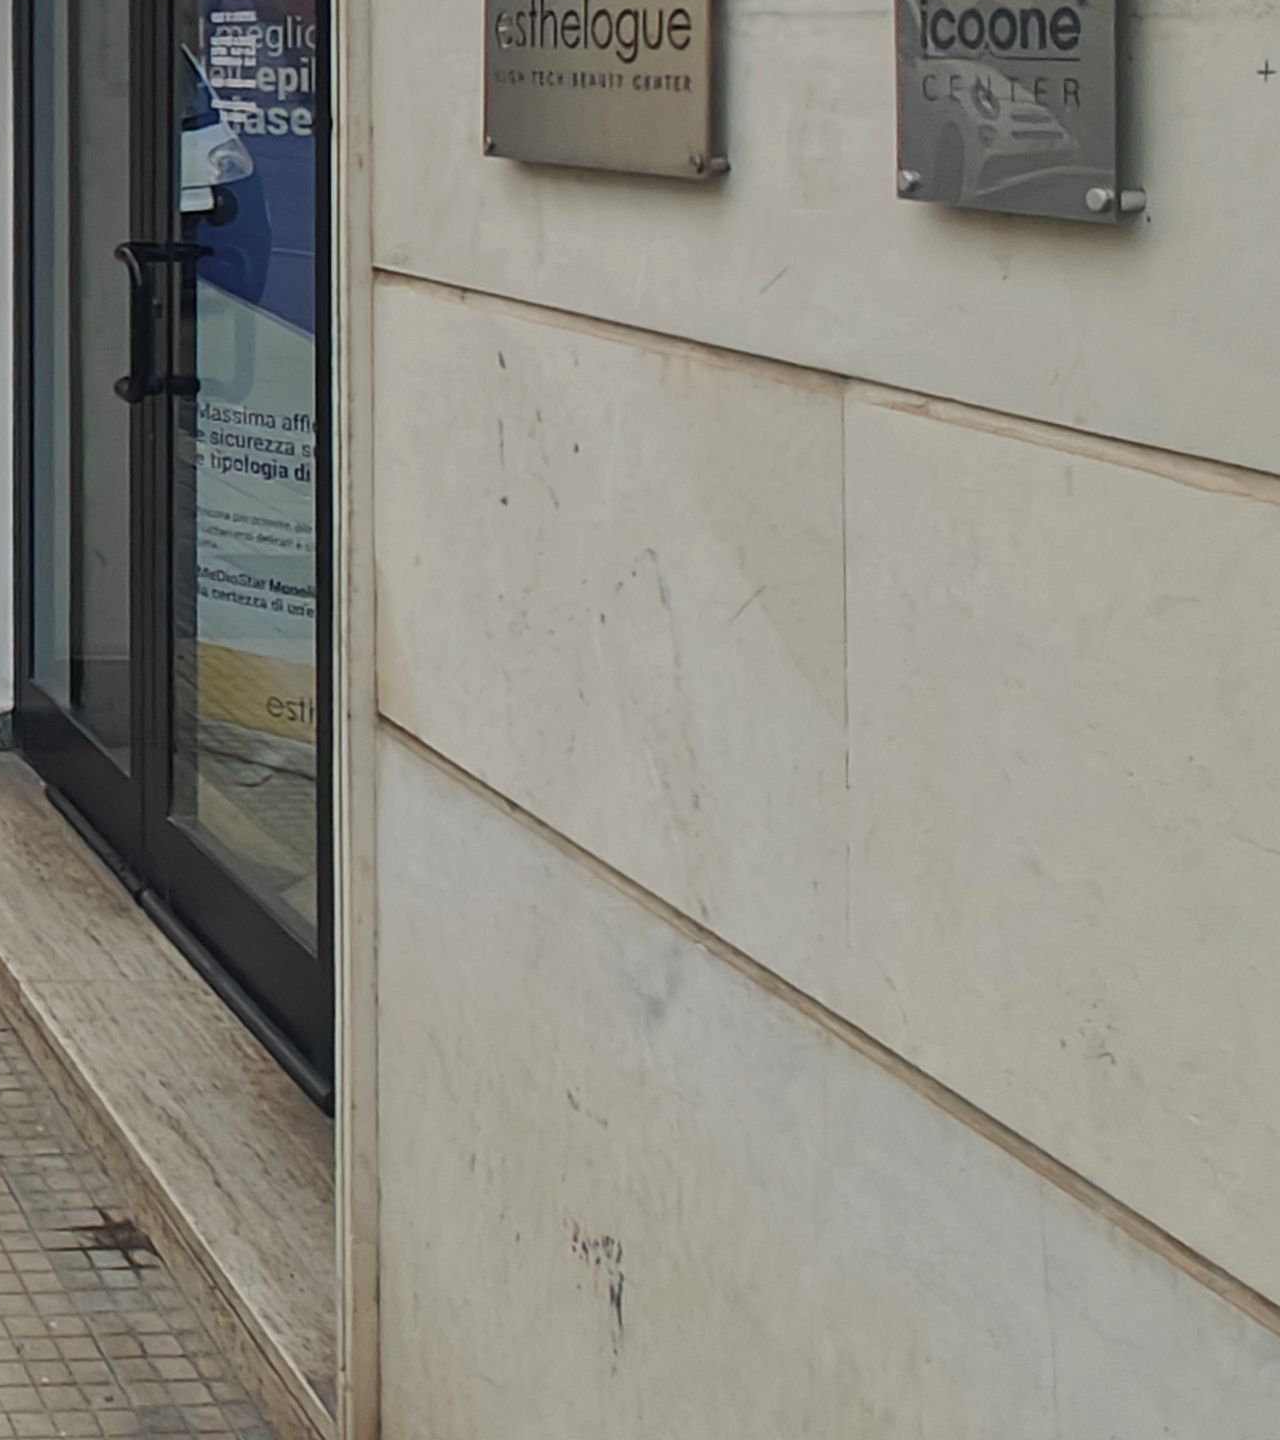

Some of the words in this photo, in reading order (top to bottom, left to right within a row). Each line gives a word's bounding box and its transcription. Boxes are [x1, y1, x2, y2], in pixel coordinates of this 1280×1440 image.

[531, 70, 563, 87] TECH
[572, 72, 624, 90] BEAUTY
[632, 73, 693, 93] CENTER
[921, 73, 1082, 109] CENTER
[281, 413, 316, 433] affi
[210, 428, 295, 456] sicurezza
[210, 450, 288, 481] tipologia
[294, 463, 311, 482] di
